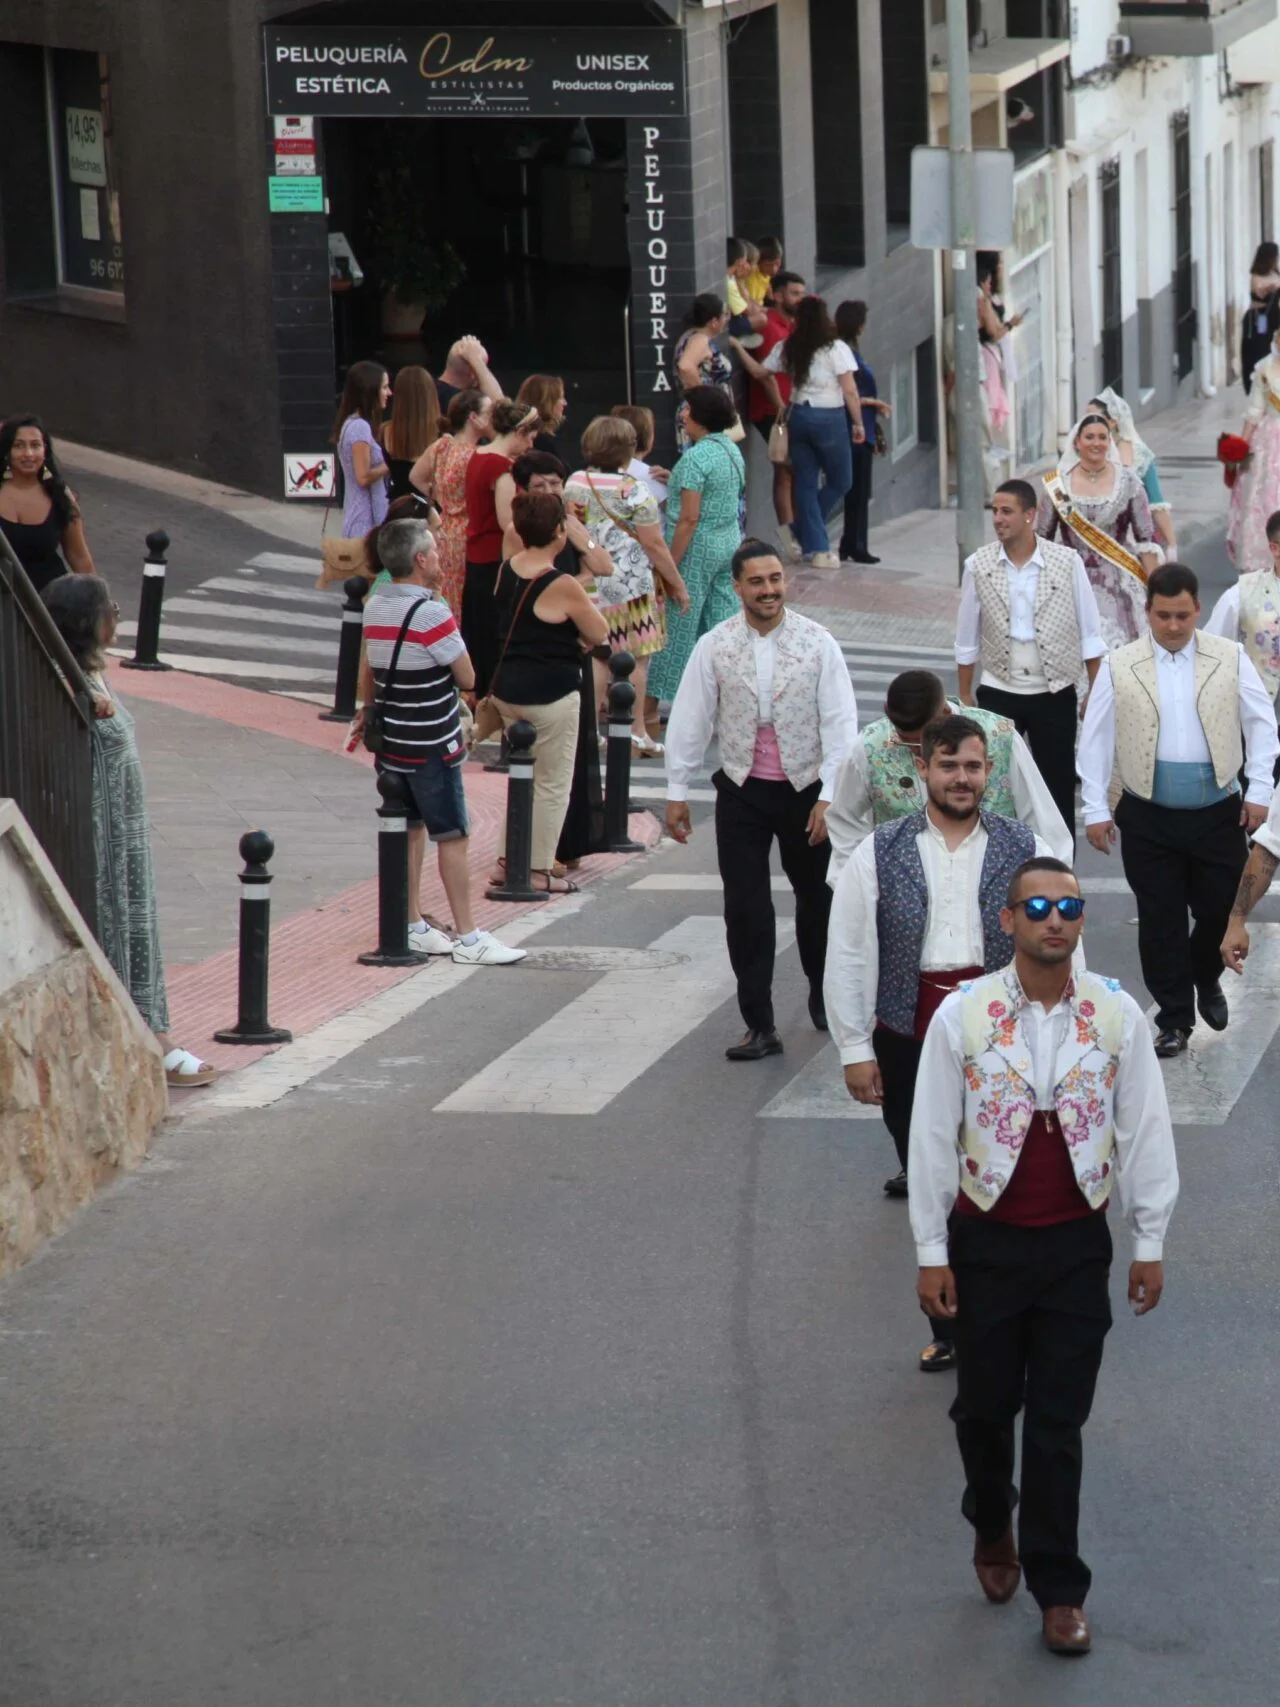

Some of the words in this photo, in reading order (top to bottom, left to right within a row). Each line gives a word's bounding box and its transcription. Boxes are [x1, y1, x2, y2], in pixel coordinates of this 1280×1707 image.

[276, 44, 408, 66] PELUQUERÍA
[420, 32, 533, 78] Cdm
[576, 54, 650, 71] UNISEX
[296, 74, 391, 94] ESTÉTICA
[431, 81, 525, 89] ESTILISTAS
[552, 80, 612, 91] Productos
[614, 80, 675, 93] Orgánicos
[89, 258, 105, 278] 96
[643, 126, 672, 392] PELUQUERIA
